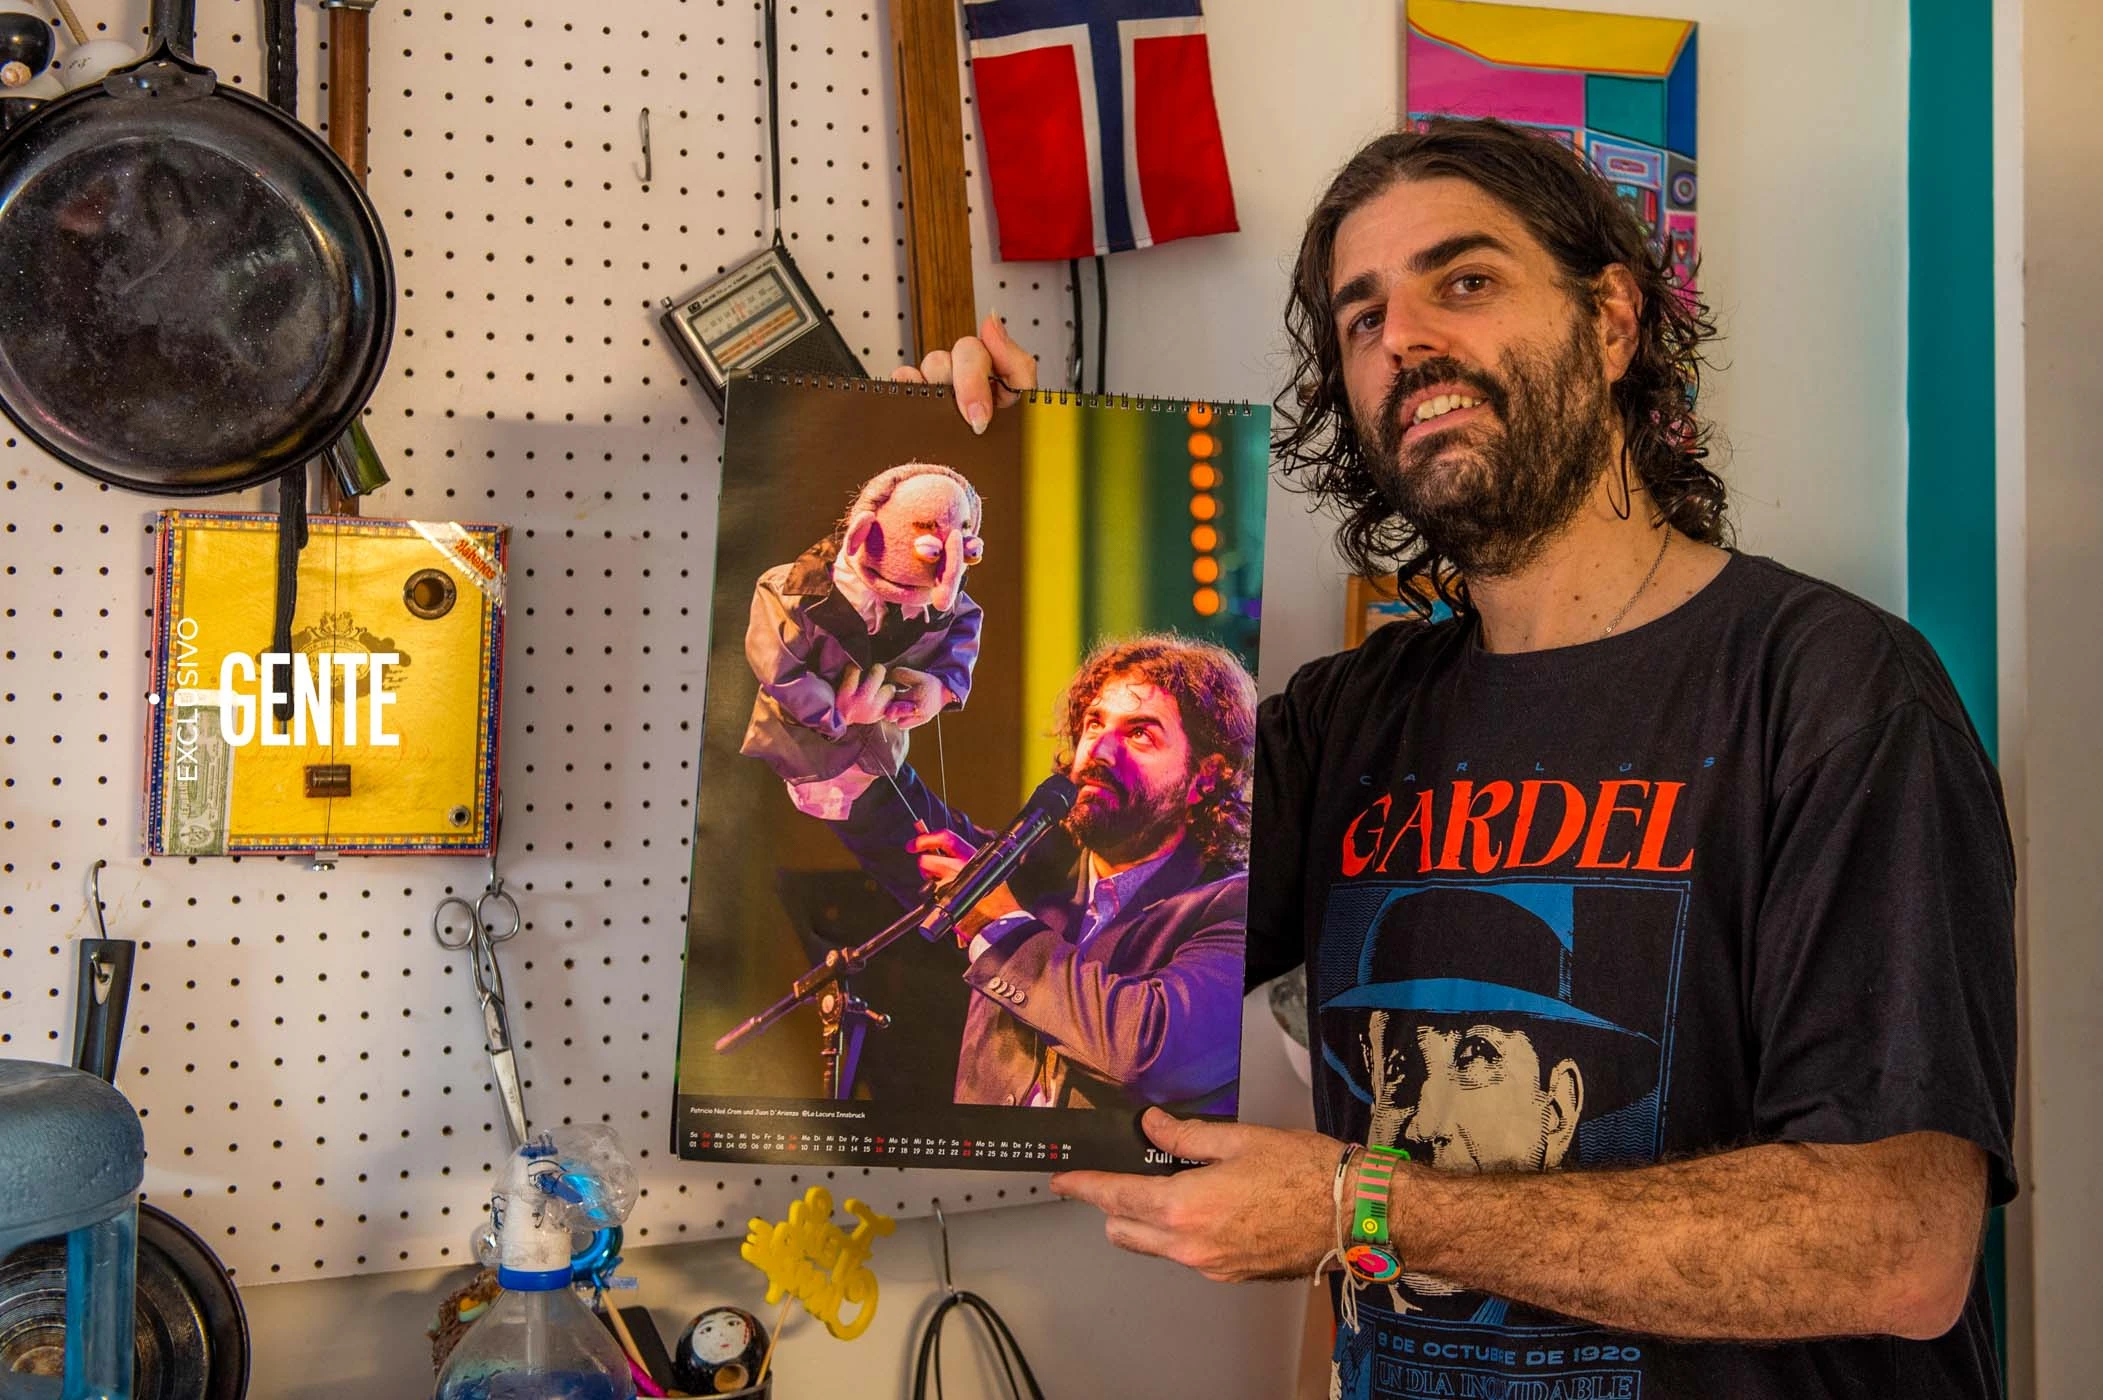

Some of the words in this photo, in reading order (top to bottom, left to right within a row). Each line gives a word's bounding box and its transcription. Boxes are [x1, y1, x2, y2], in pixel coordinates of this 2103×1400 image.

[1341, 779, 1695, 877] GARDEL
[1392, 1335, 1415, 1354] DE
[1526, 1350, 1565, 1366] DE
[1573, 1345, 1641, 1363] 1920
[1379, 1360, 1403, 1391] UN
[1406, 1367, 1455, 1397] DIA
